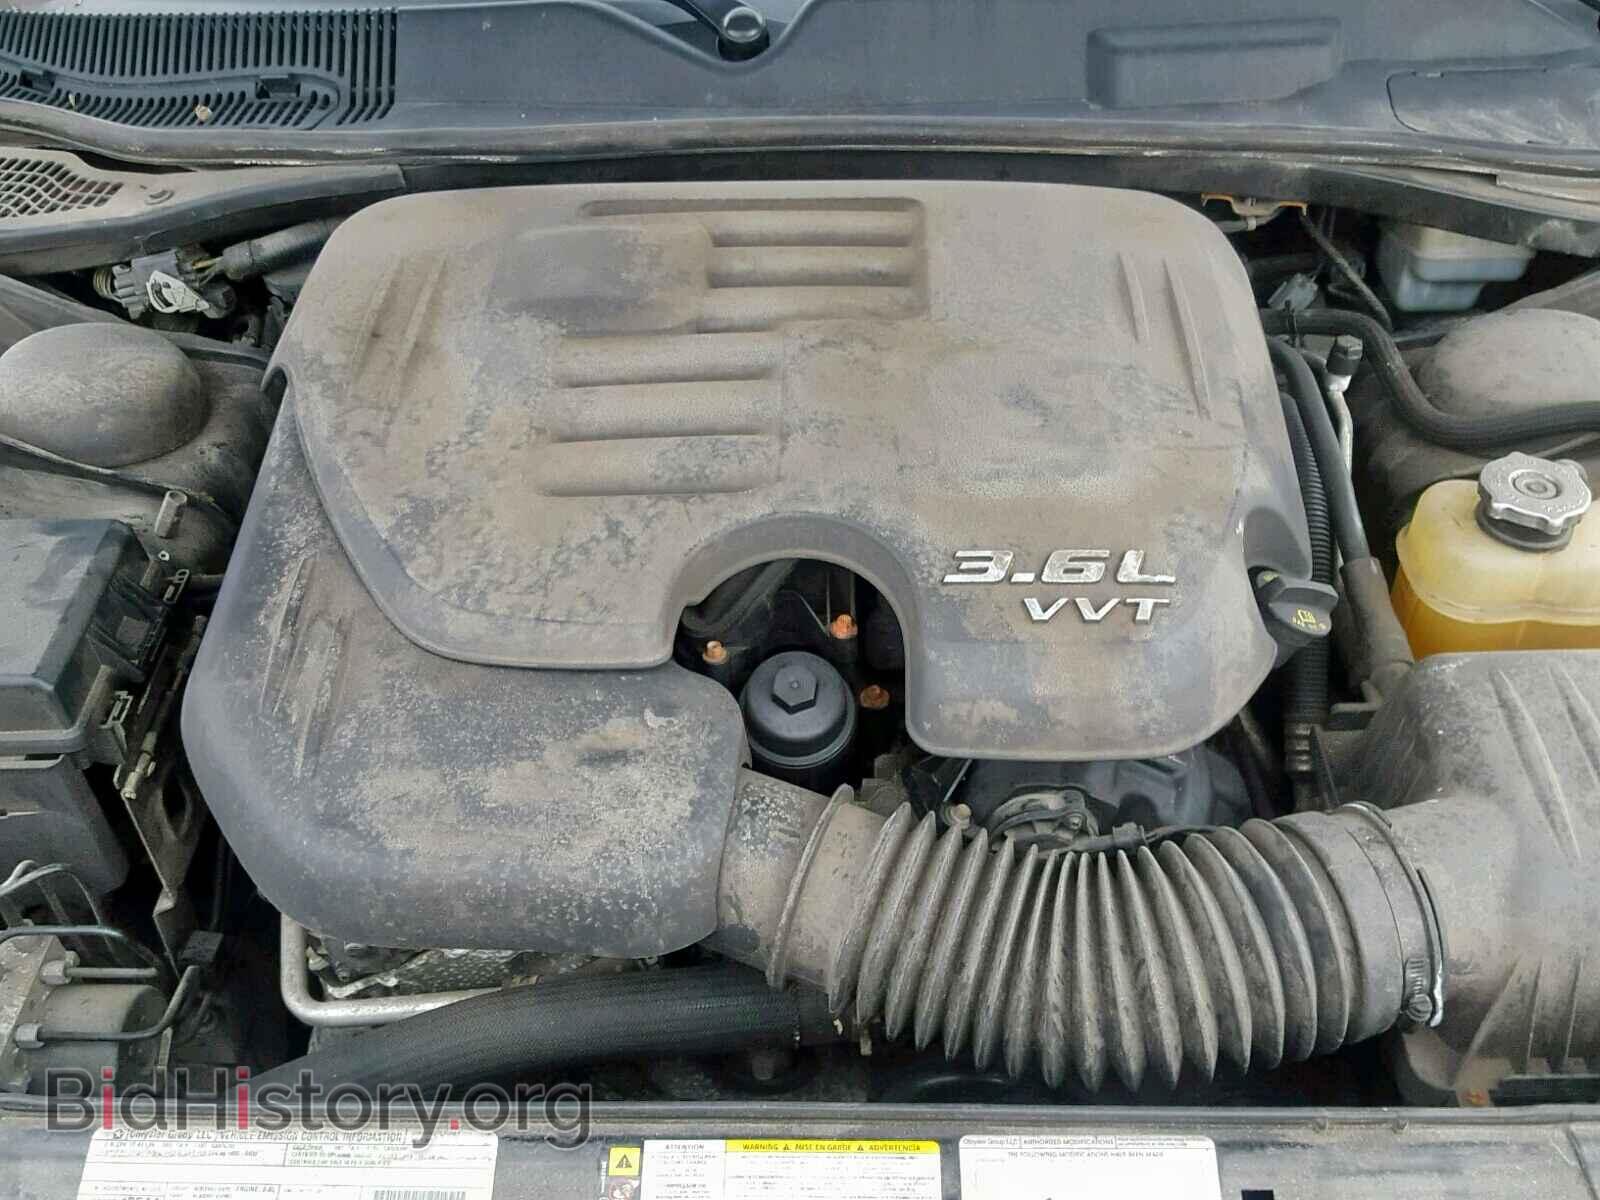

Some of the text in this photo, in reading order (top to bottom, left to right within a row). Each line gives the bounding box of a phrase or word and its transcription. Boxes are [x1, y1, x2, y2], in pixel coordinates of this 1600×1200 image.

[943, 549, 1176, 584] 3.6L
[1023, 597, 1170, 624] VVT
[301, 1132, 339, 1142] CONTROL
[742, 1143, 779, 1151] WARNING
